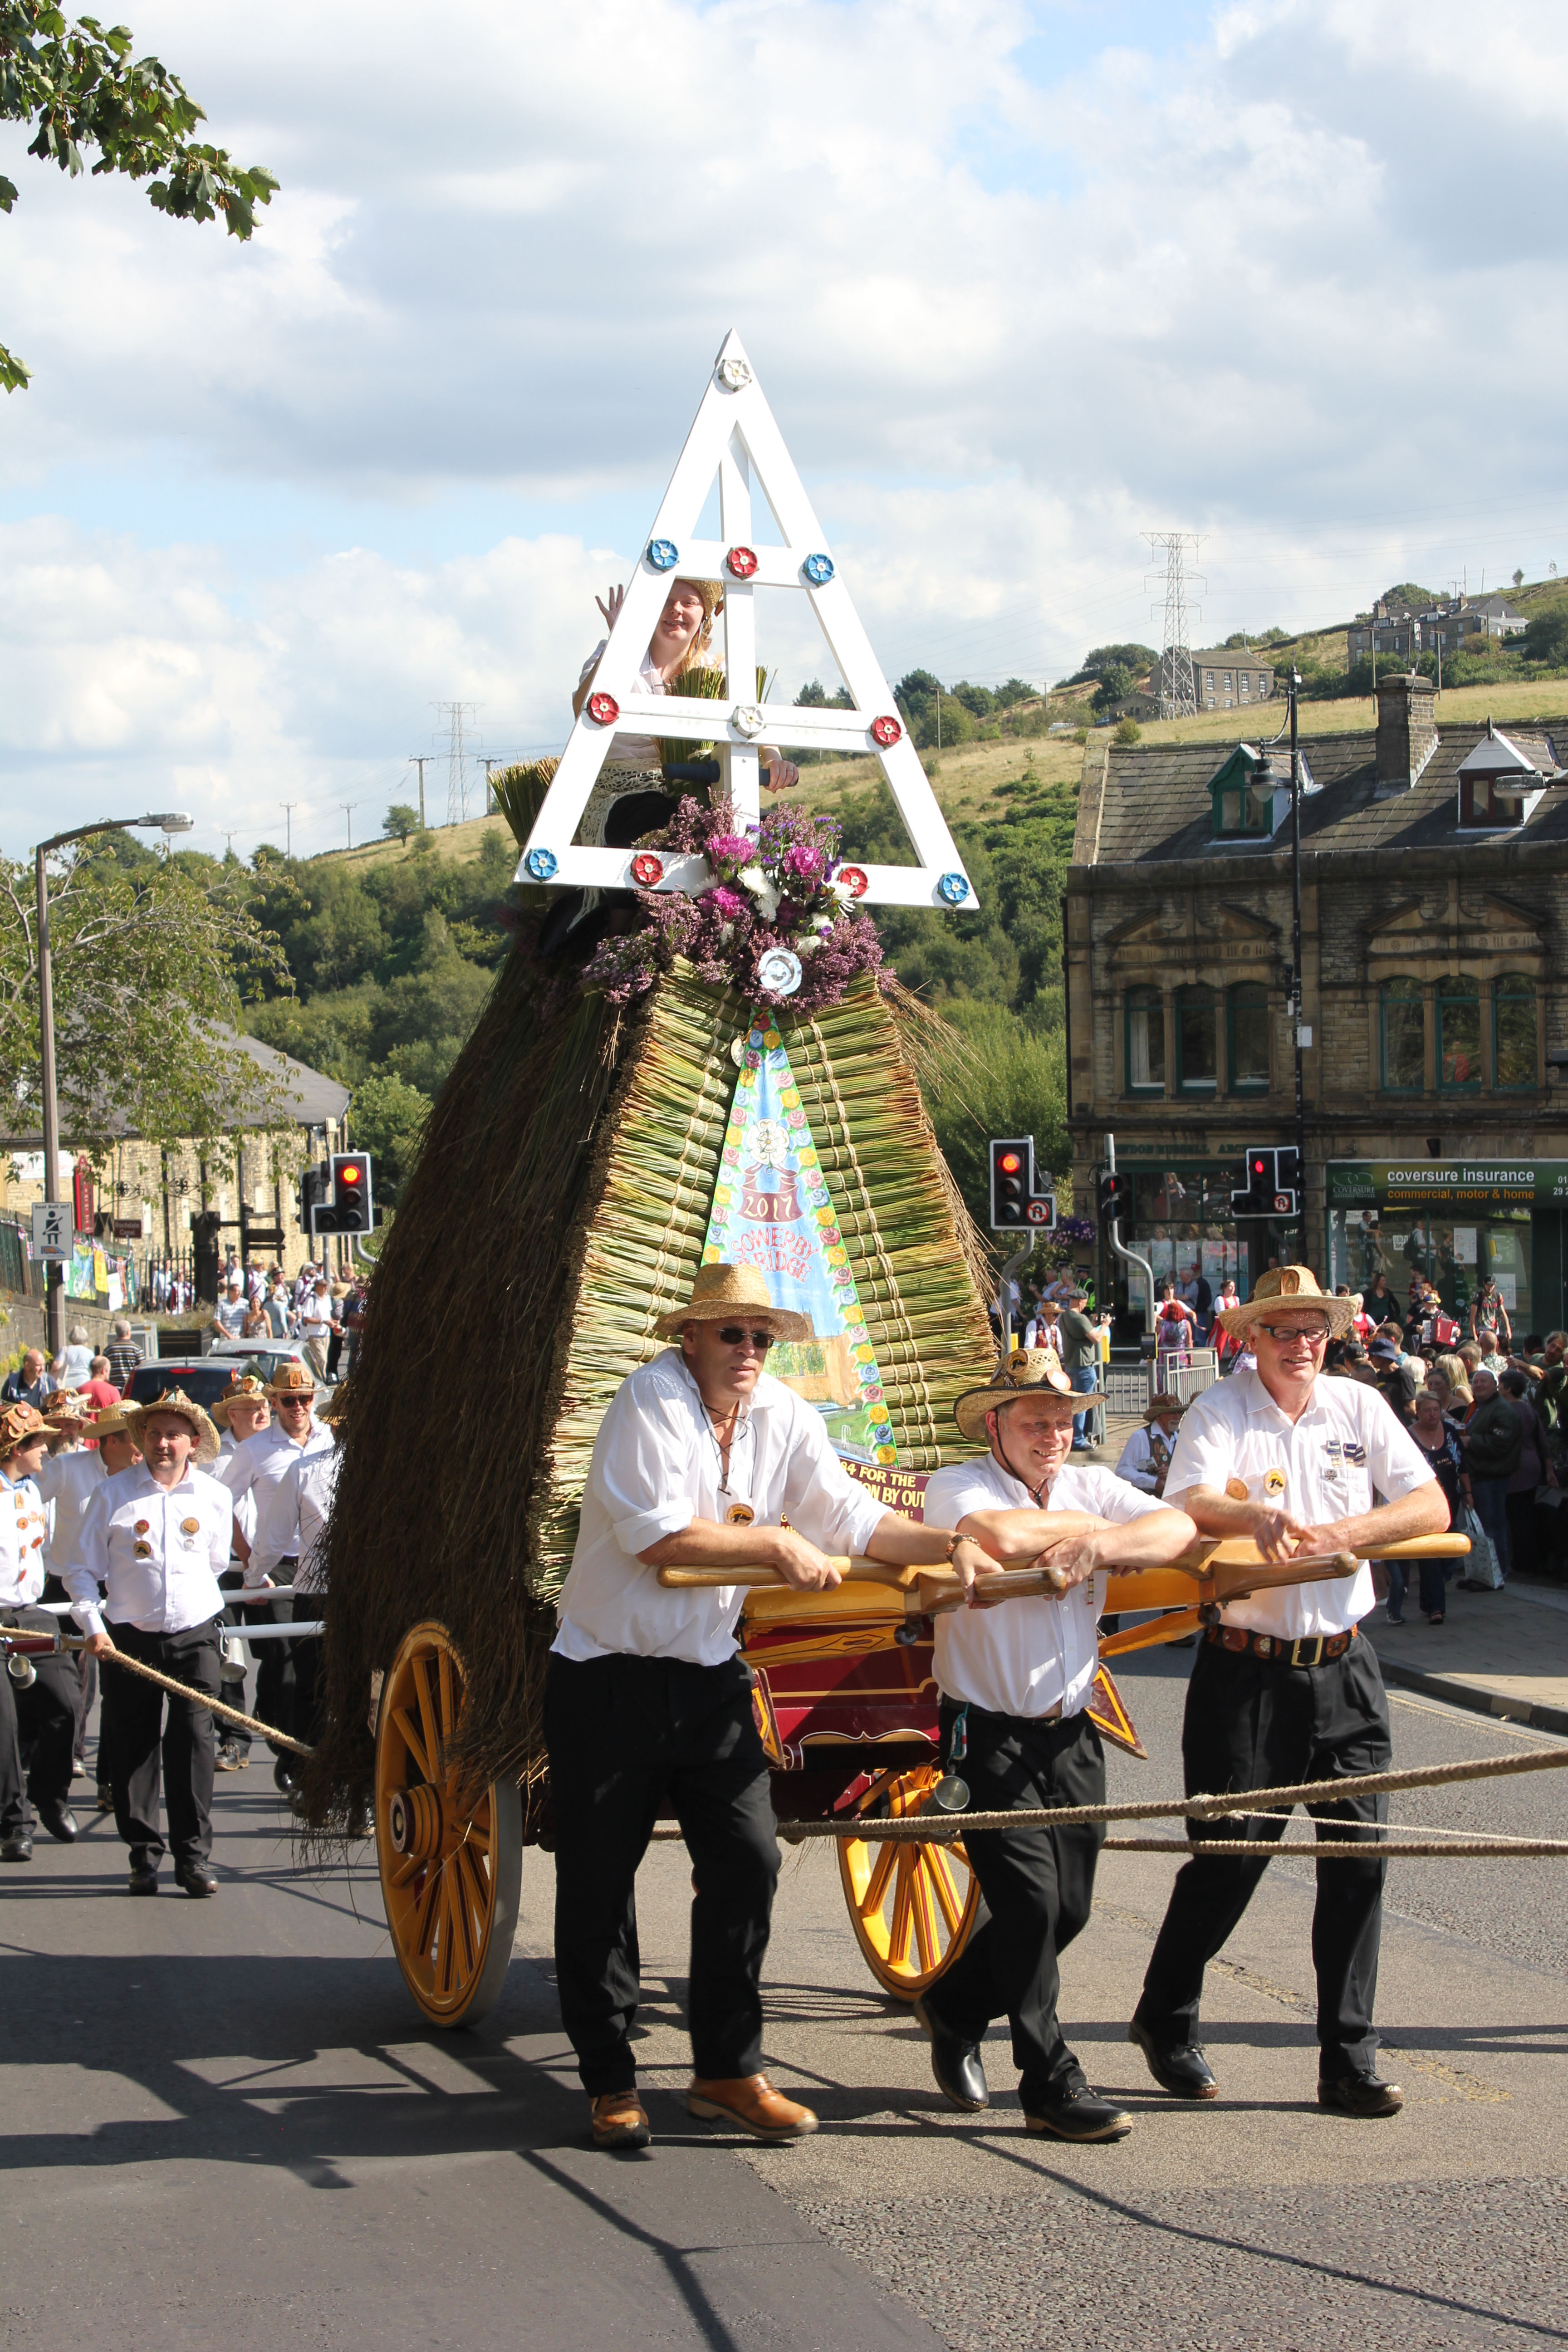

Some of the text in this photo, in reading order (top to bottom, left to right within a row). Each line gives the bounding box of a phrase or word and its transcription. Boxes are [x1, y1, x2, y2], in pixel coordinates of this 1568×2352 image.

[1387, 1168, 1534, 1182] coversure insurance
[1388, 1188, 1453, 1200] commercial,
[1457, 1190, 1489, 1199] motor
[1492, 1189, 1500, 1199] &
[1504, 1188, 1534, 1199] home
[744, 1196, 792, 1220] 2017
[731, 1227, 819, 1262] SOWERBY
[859, 1465, 887, 1484] FOR
[890, 1473, 916, 1488] THE
[882, 1486, 901, 1504] BY
